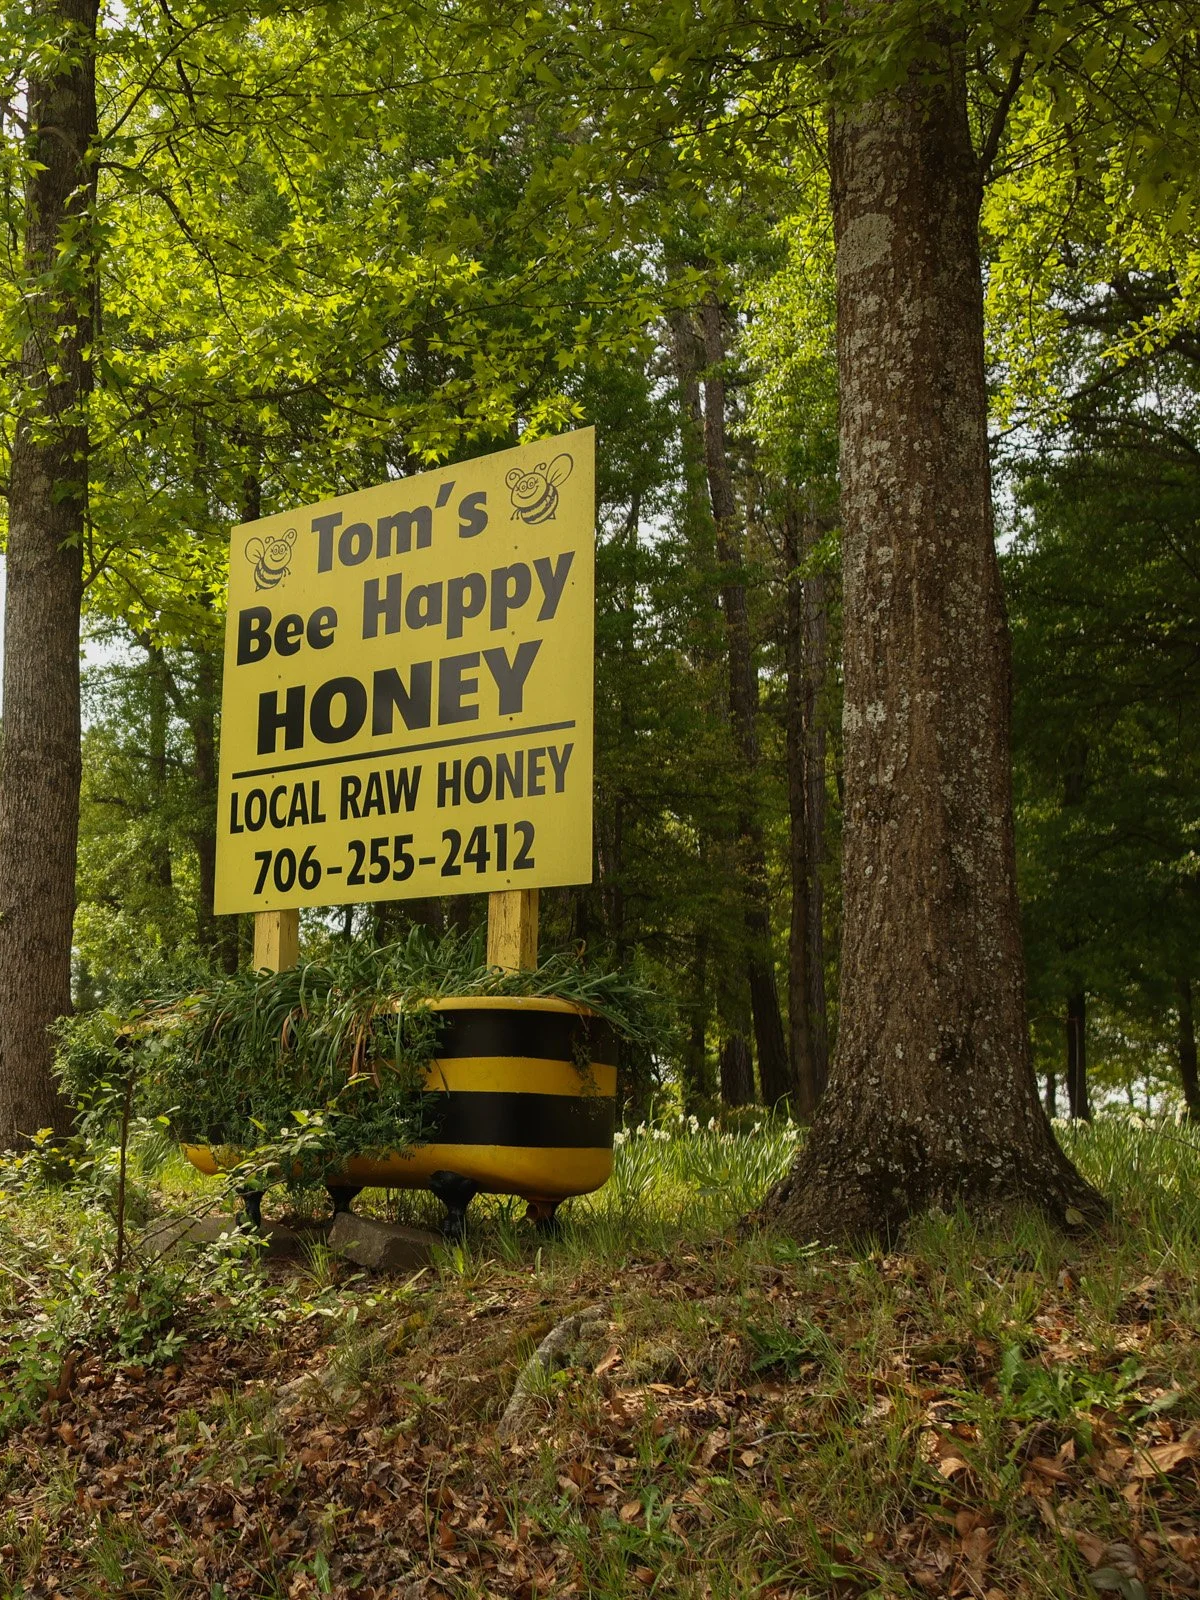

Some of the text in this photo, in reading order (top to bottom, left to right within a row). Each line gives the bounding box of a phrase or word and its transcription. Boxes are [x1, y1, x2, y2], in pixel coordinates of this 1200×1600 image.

[311, 480, 488, 574] Tom's
[236, 550, 576, 666] Bee Happy
[256, 638, 543, 755] HONEY
[229, 742, 575, 835] LOCAL RAW HONEY
[253, 820, 536, 895] 706-255-2412
